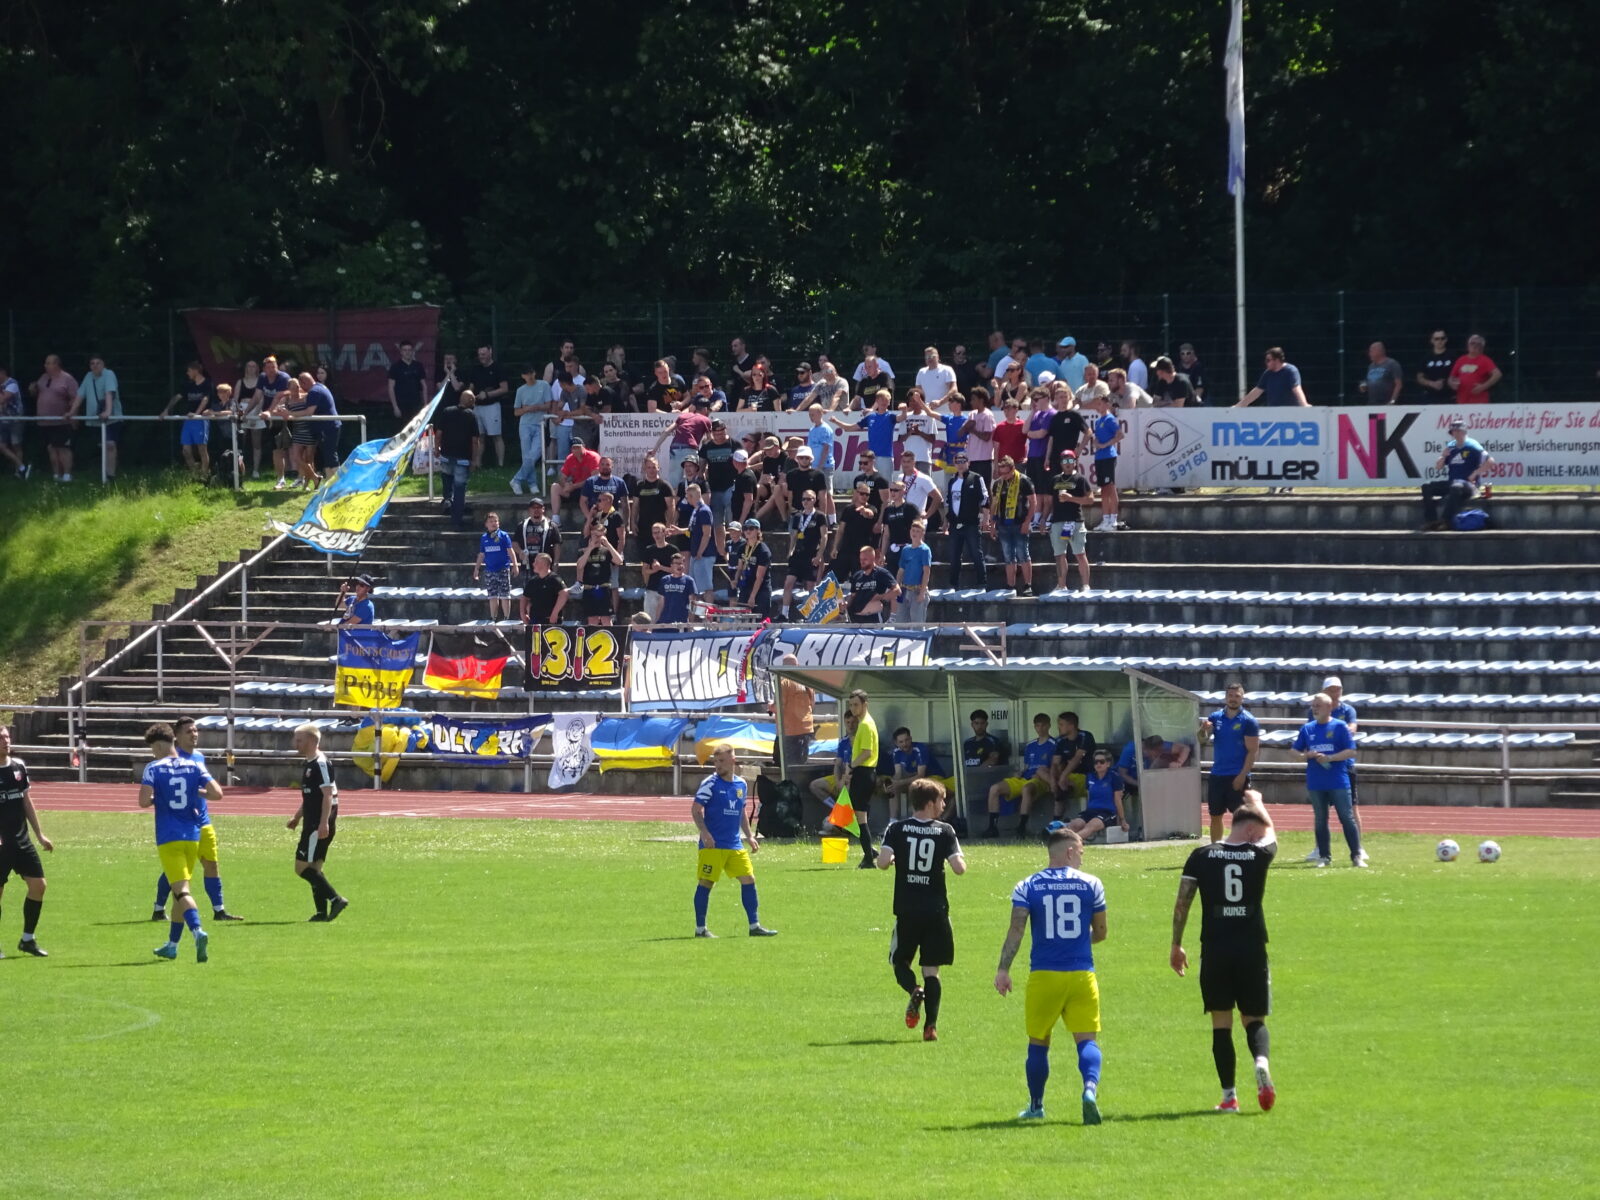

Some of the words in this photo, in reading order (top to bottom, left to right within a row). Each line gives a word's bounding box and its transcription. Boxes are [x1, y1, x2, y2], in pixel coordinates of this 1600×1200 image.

[603, 418, 640, 429] MÜLKER
[1467, 410, 1536, 429] Sicherheit
[1536, 410, 1562, 434] für
[1565, 411, 1586, 428] Sie
[604, 430, 652, 438] Schrotthandel
[1338, 412, 1421, 479] NK
[1424, 441, 1442, 453] Die
[169, 776, 188, 810] 3
[902, 824, 942, 835] AMMENDORF
[906, 836, 936, 872] 19
[1208, 849, 1256, 861] AMMENDORF
[1224, 863, 1243, 903] 6
[1042, 894, 1082, 939] 18
[1223, 906, 1247, 917] KUNZE
